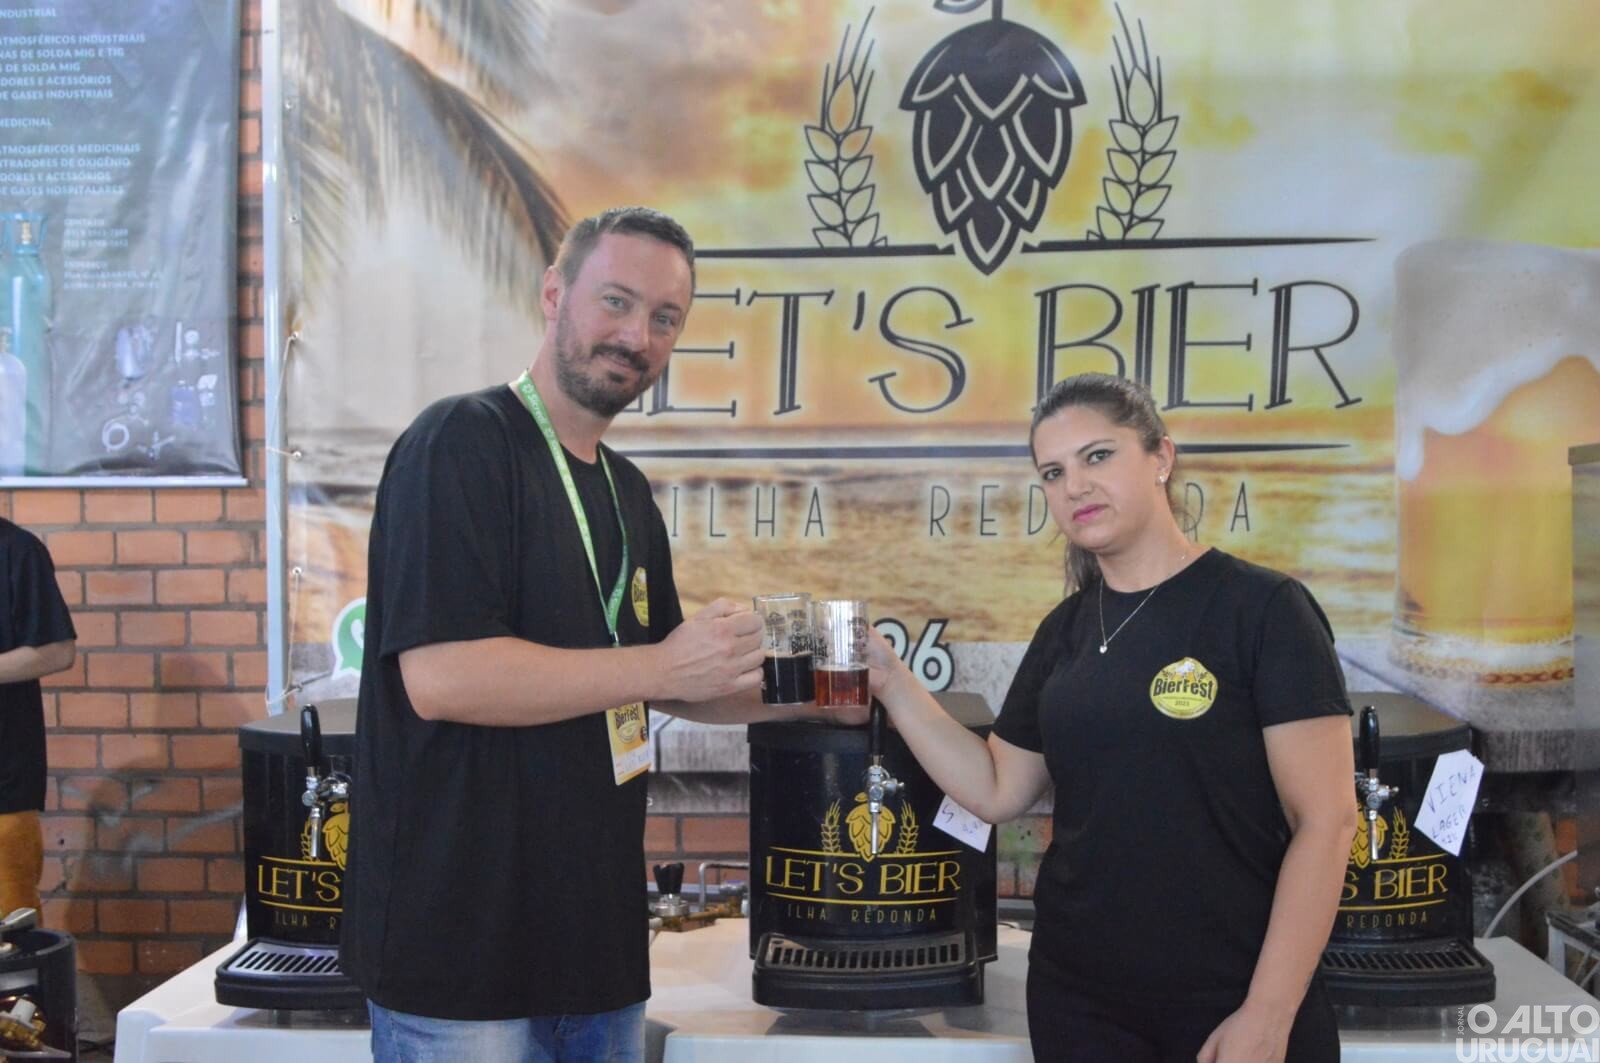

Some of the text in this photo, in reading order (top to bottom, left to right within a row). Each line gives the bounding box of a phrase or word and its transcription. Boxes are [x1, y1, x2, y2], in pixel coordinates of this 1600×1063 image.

[79, 34, 146, 45] INDUSTRIAIS
[20, 50, 33, 59] DE
[37, 49, 72, 59] SOLDA
[74, 49, 95, 58] MIG
[107, 47, 124, 57] TIG
[5, 64, 18, 73] DE
[22, 63, 56, 73] SOLDA
[59, 62, 80, 72] MIG
[11, 91, 43, 100] GASES
[46, 88, 113, 99] INDUSTRIAIS
[0, 143, 140, 155] TMOSFÉRICOS MEDICINAIS
[60, 158, 75, 168] DE
[622, 277, 1362, 417] ET'S BIER
[672, 481, 1250, 537] ILHA REDDA
[258, 864, 341, 902] LET'S
[766, 855, 961, 895] LET'S BIER
[1374, 863, 1448, 900] BIER
[275, 910, 308, 927] ILHA
[787, 903, 937, 924] ILHA REDONDA
[1346, 911, 1428, 929] REDONDA
